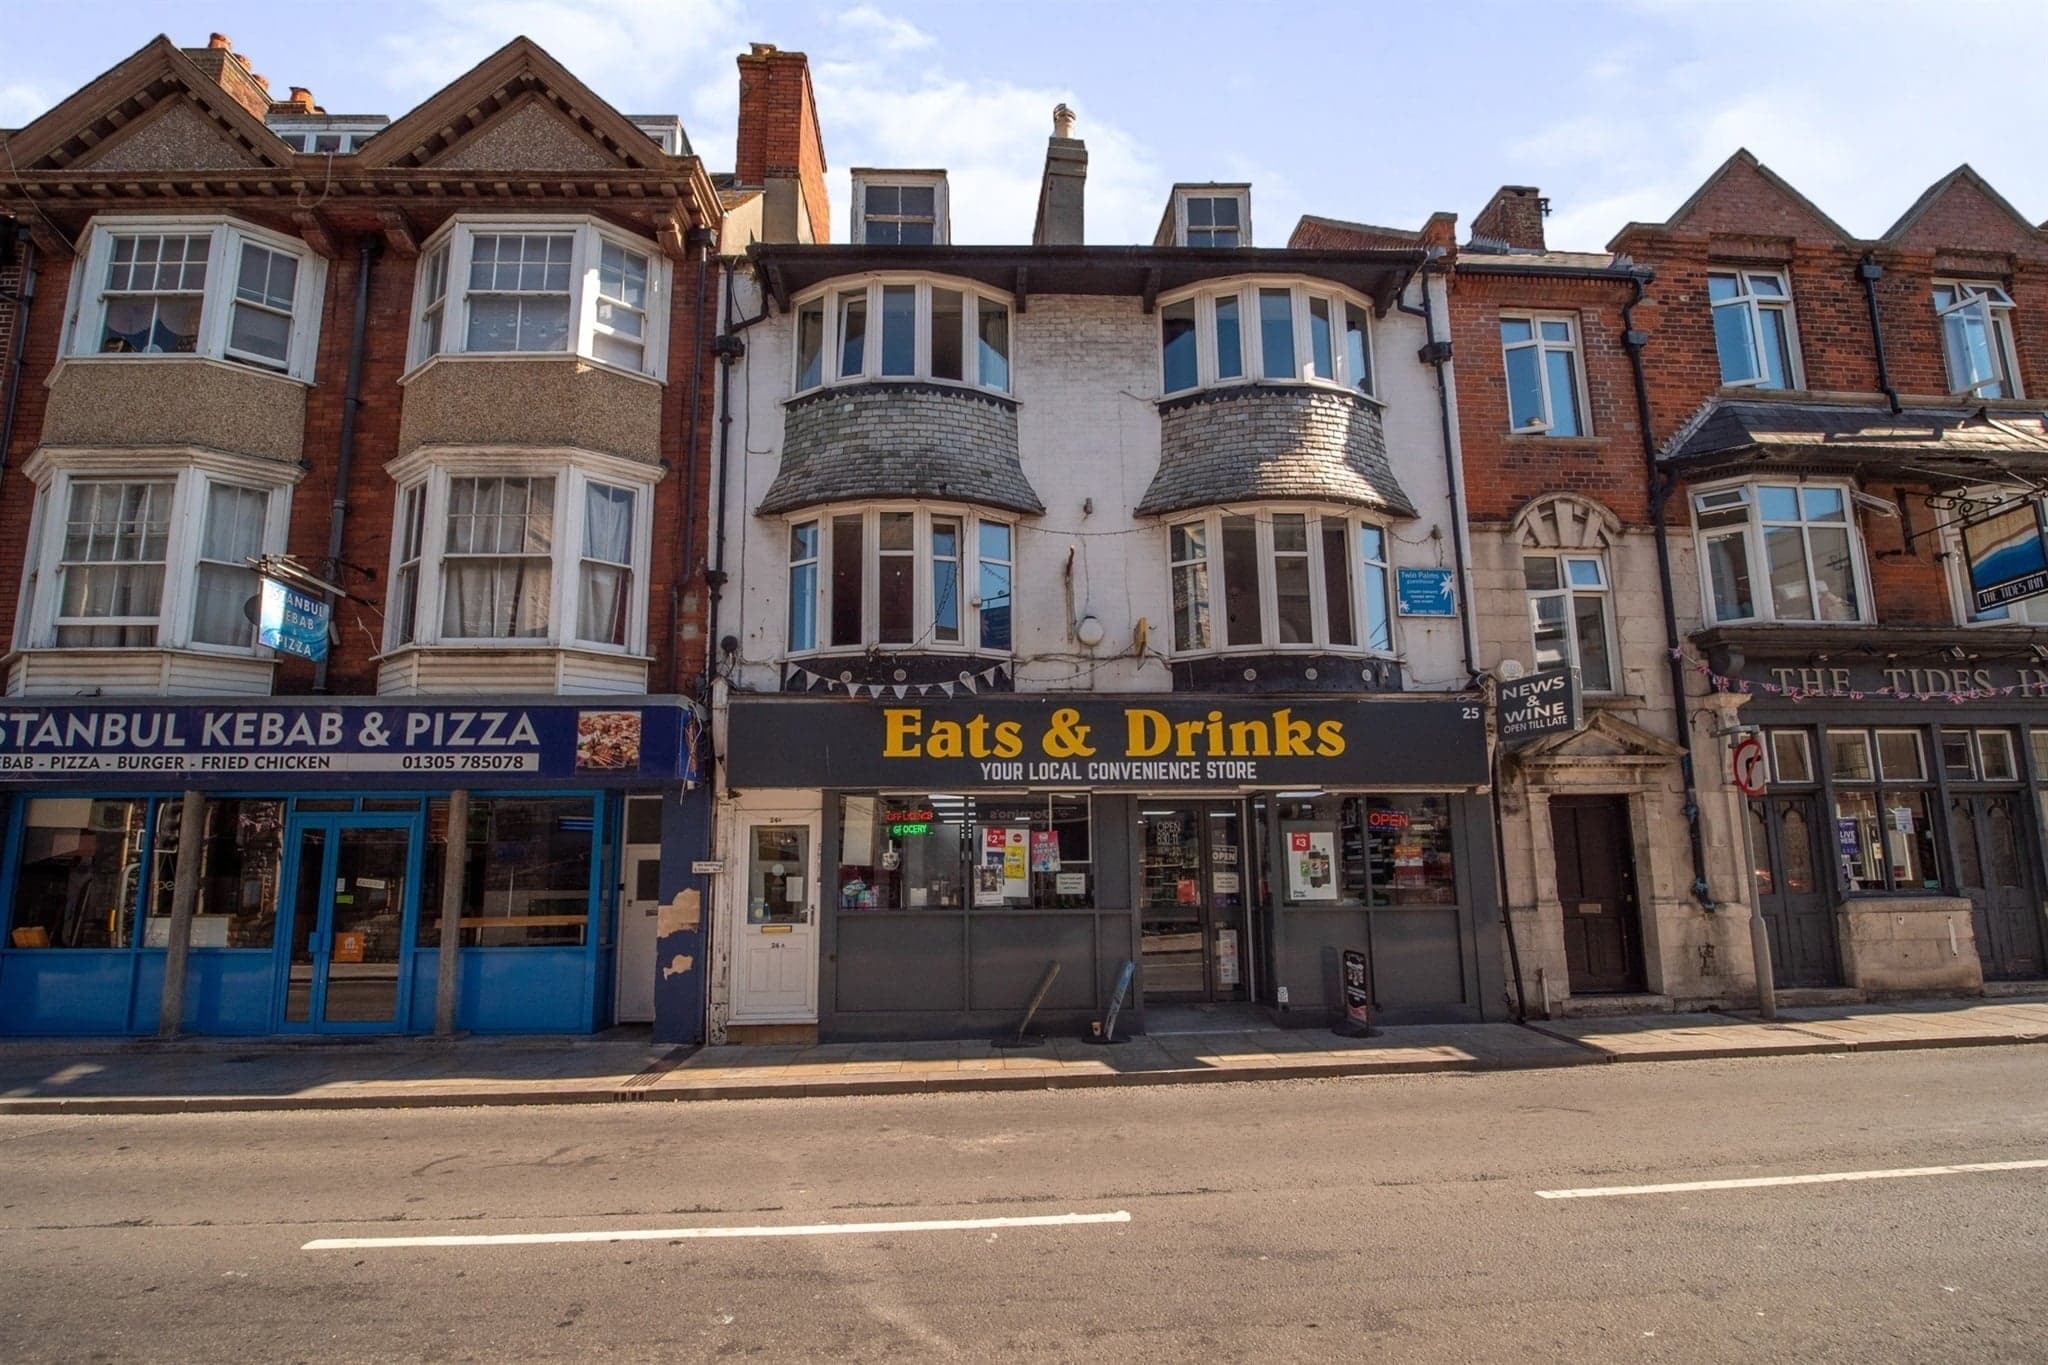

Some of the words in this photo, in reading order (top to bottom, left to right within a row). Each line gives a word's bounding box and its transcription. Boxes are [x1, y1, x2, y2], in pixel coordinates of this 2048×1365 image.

[1982, 591, 1998, 605] THE
[2000, 582, 2027, 599] TIDES
[275, 633, 312, 657] PIZZA
[1502, 676, 1565, 700] NEWS
[1771, 668, 1851, 698] THE
[1883, 668, 1994, 699] TIDES
[1526, 695, 1541, 707] &
[1462, 707, 1480, 719] 25
[1504, 702, 1564, 723] WINE
[201, 712, 344, 747] KEBAB
[358, 712, 390, 747] &
[405, 711, 541, 746] PIZZA
[882, 707, 1024, 759] Eats
[1042, 707, 1097, 758] &
[1124, 707, 1346, 758] Drinks
[1503, 722, 1527, 734] OPEN
[1528, 719, 1545, 730] TILL
[1547, 715, 1568, 727] LATE
[0, 755, 34, 770] BAB
[50, 755, 100, 770] PIZZA
[117, 755, 184, 770] BURGER
[201, 755, 249, 770] FRIED
[254, 755, 331, 770] CHICKEN
[402, 755, 455, 770] 01305
[460, 755, 524, 770] 785078
[980, 761, 1024, 781] YOUR
[1029, 761, 1082, 781] LOCAL
[1088, 761, 1201, 780] CONVENIENCE
[1206, 761, 1257, 780] STORE
[1156, 821, 1181, 833] OPEN
[1369, 812, 1409, 827] OPEN
[1211, 851, 1236, 861] OPEN
